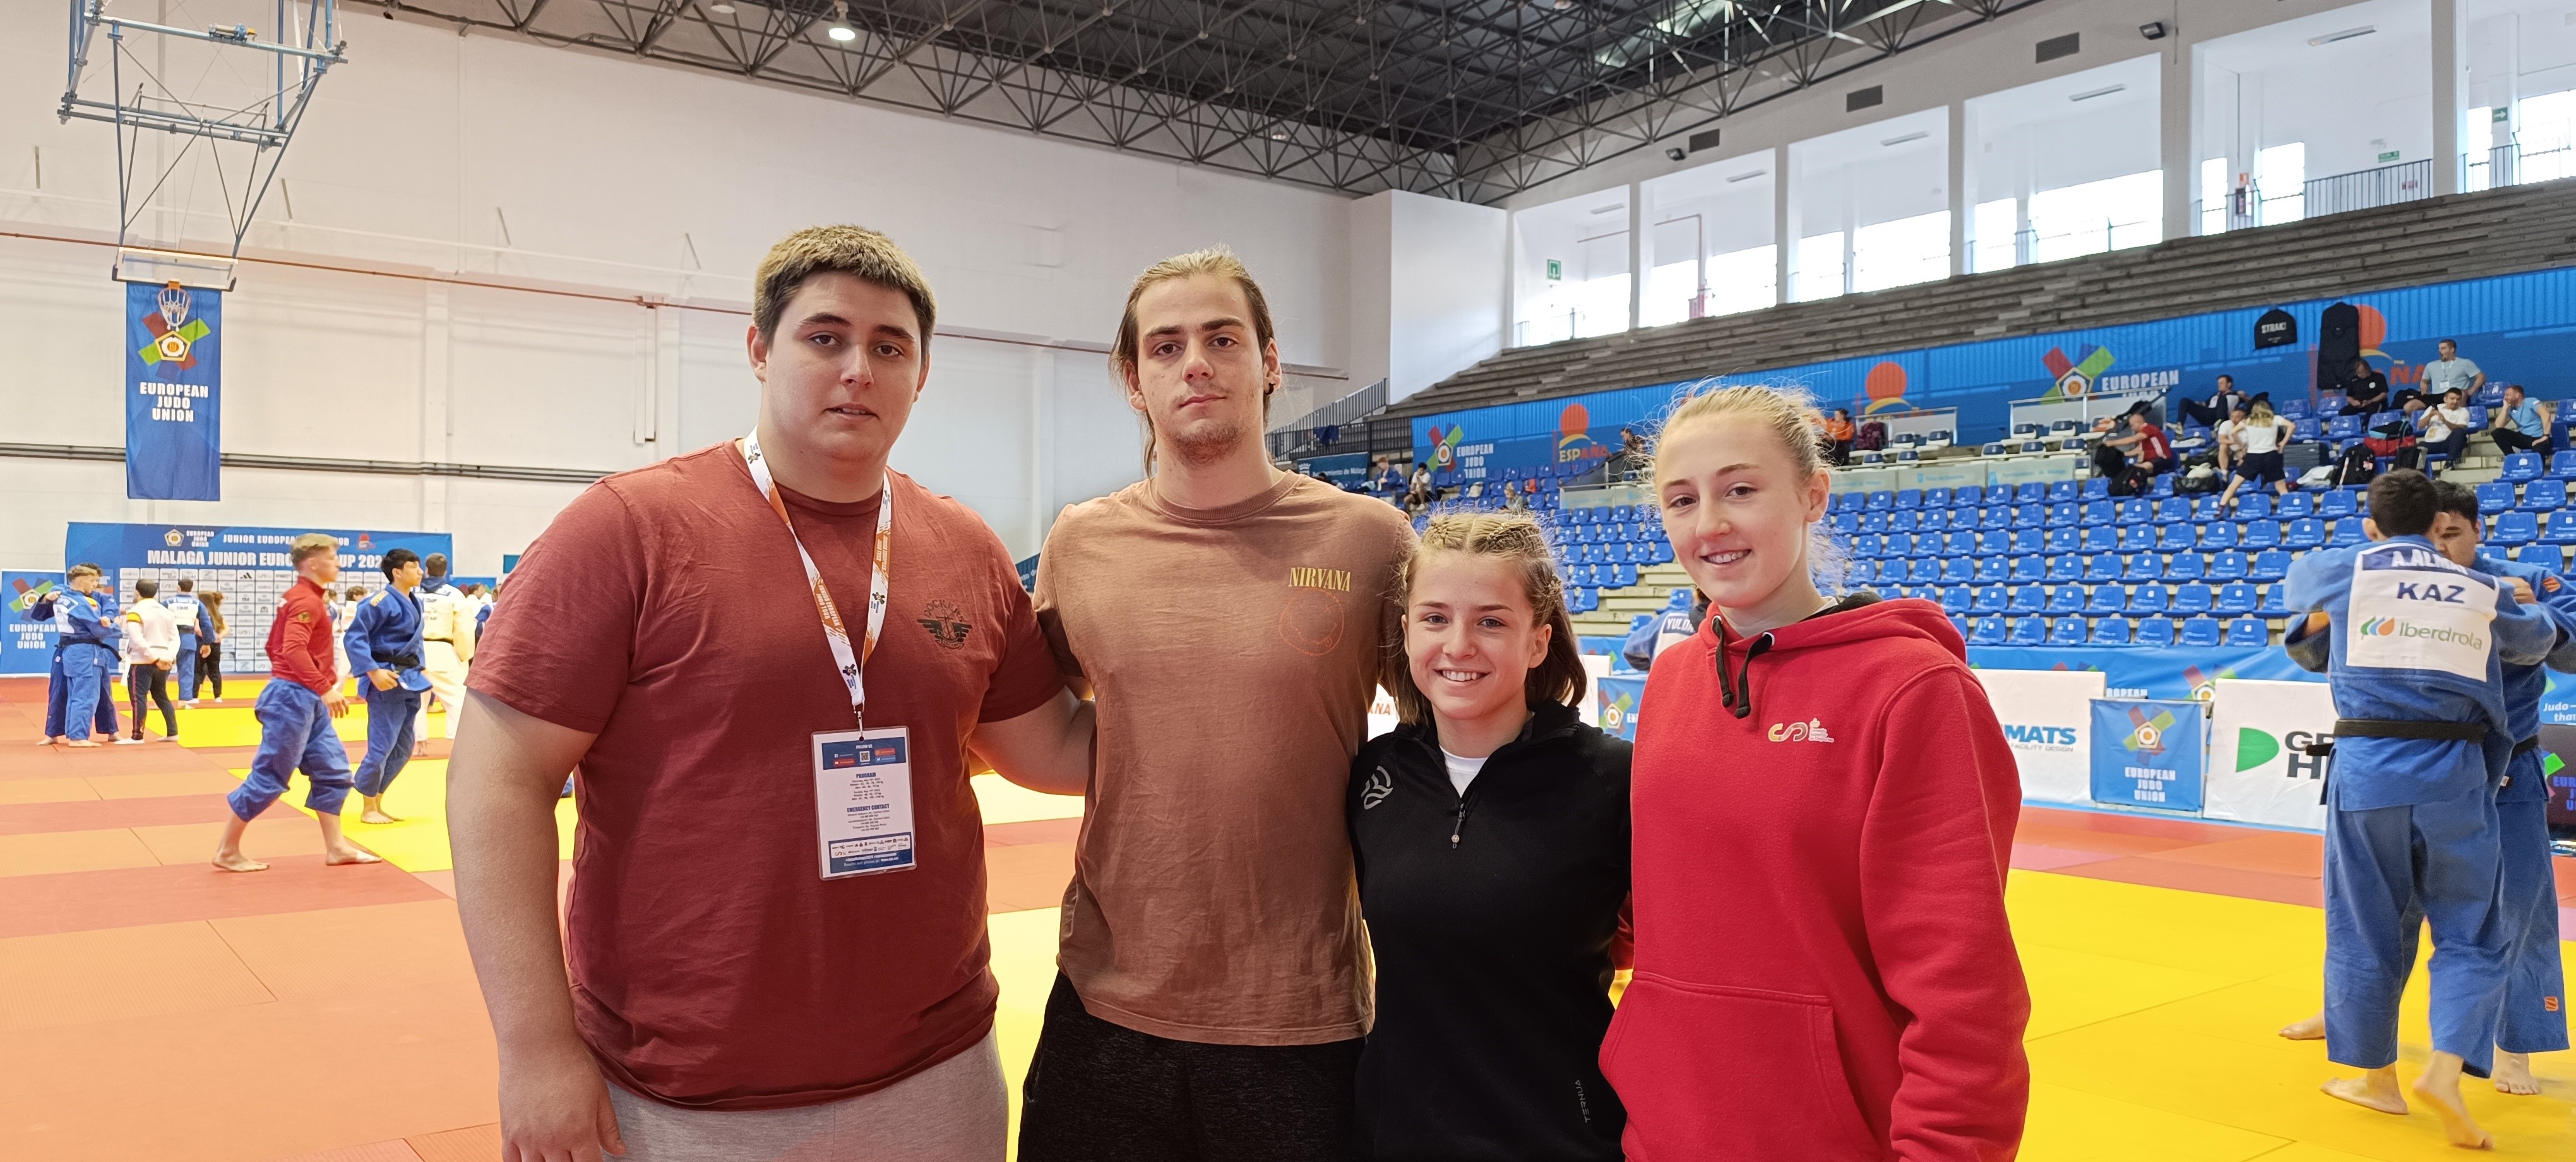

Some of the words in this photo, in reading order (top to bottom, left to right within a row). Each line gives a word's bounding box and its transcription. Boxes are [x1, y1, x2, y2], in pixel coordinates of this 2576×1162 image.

[2102, 369, 2179, 391] EUROPEAN
[140, 382, 208, 398] EUROPEAN
[157, 396, 191, 409] JUDO
[152, 408, 194, 422] UNION
[1457, 443, 1494, 457] EUROPEAN
[1465, 455, 1484, 467] JUDO
[223, 534, 254, 543] JUNIOR
[257, 535, 295, 545] EUROPEA
[147, 550, 205, 565] MALAGA
[207, 551, 256, 566] JUNIOR
[259, 553, 293, 567] EURO
[358, 554, 383, 569] 202
[1288, 567, 1351, 592] NIRVANA
[2397, 582, 2465, 604] KAZ
[816, 593, 825, 607] JUDO
[821, 606, 831, 620] TOUR
[818, 585, 830, 602] JUNIOR
[826, 601, 840, 626] EUROPEAN
[924, 599, 963, 622] DOCKERS
[9, 624, 56, 632] EUROPEAN
[2399, 622, 2483, 650] Iberdrola
[2125, 767, 2176, 781] EUROPEAN
[2138, 779, 2162, 791] JUDO
[2134, 789, 2166, 803] UNION
[1575, 1079, 1591, 1123] TERNUA
